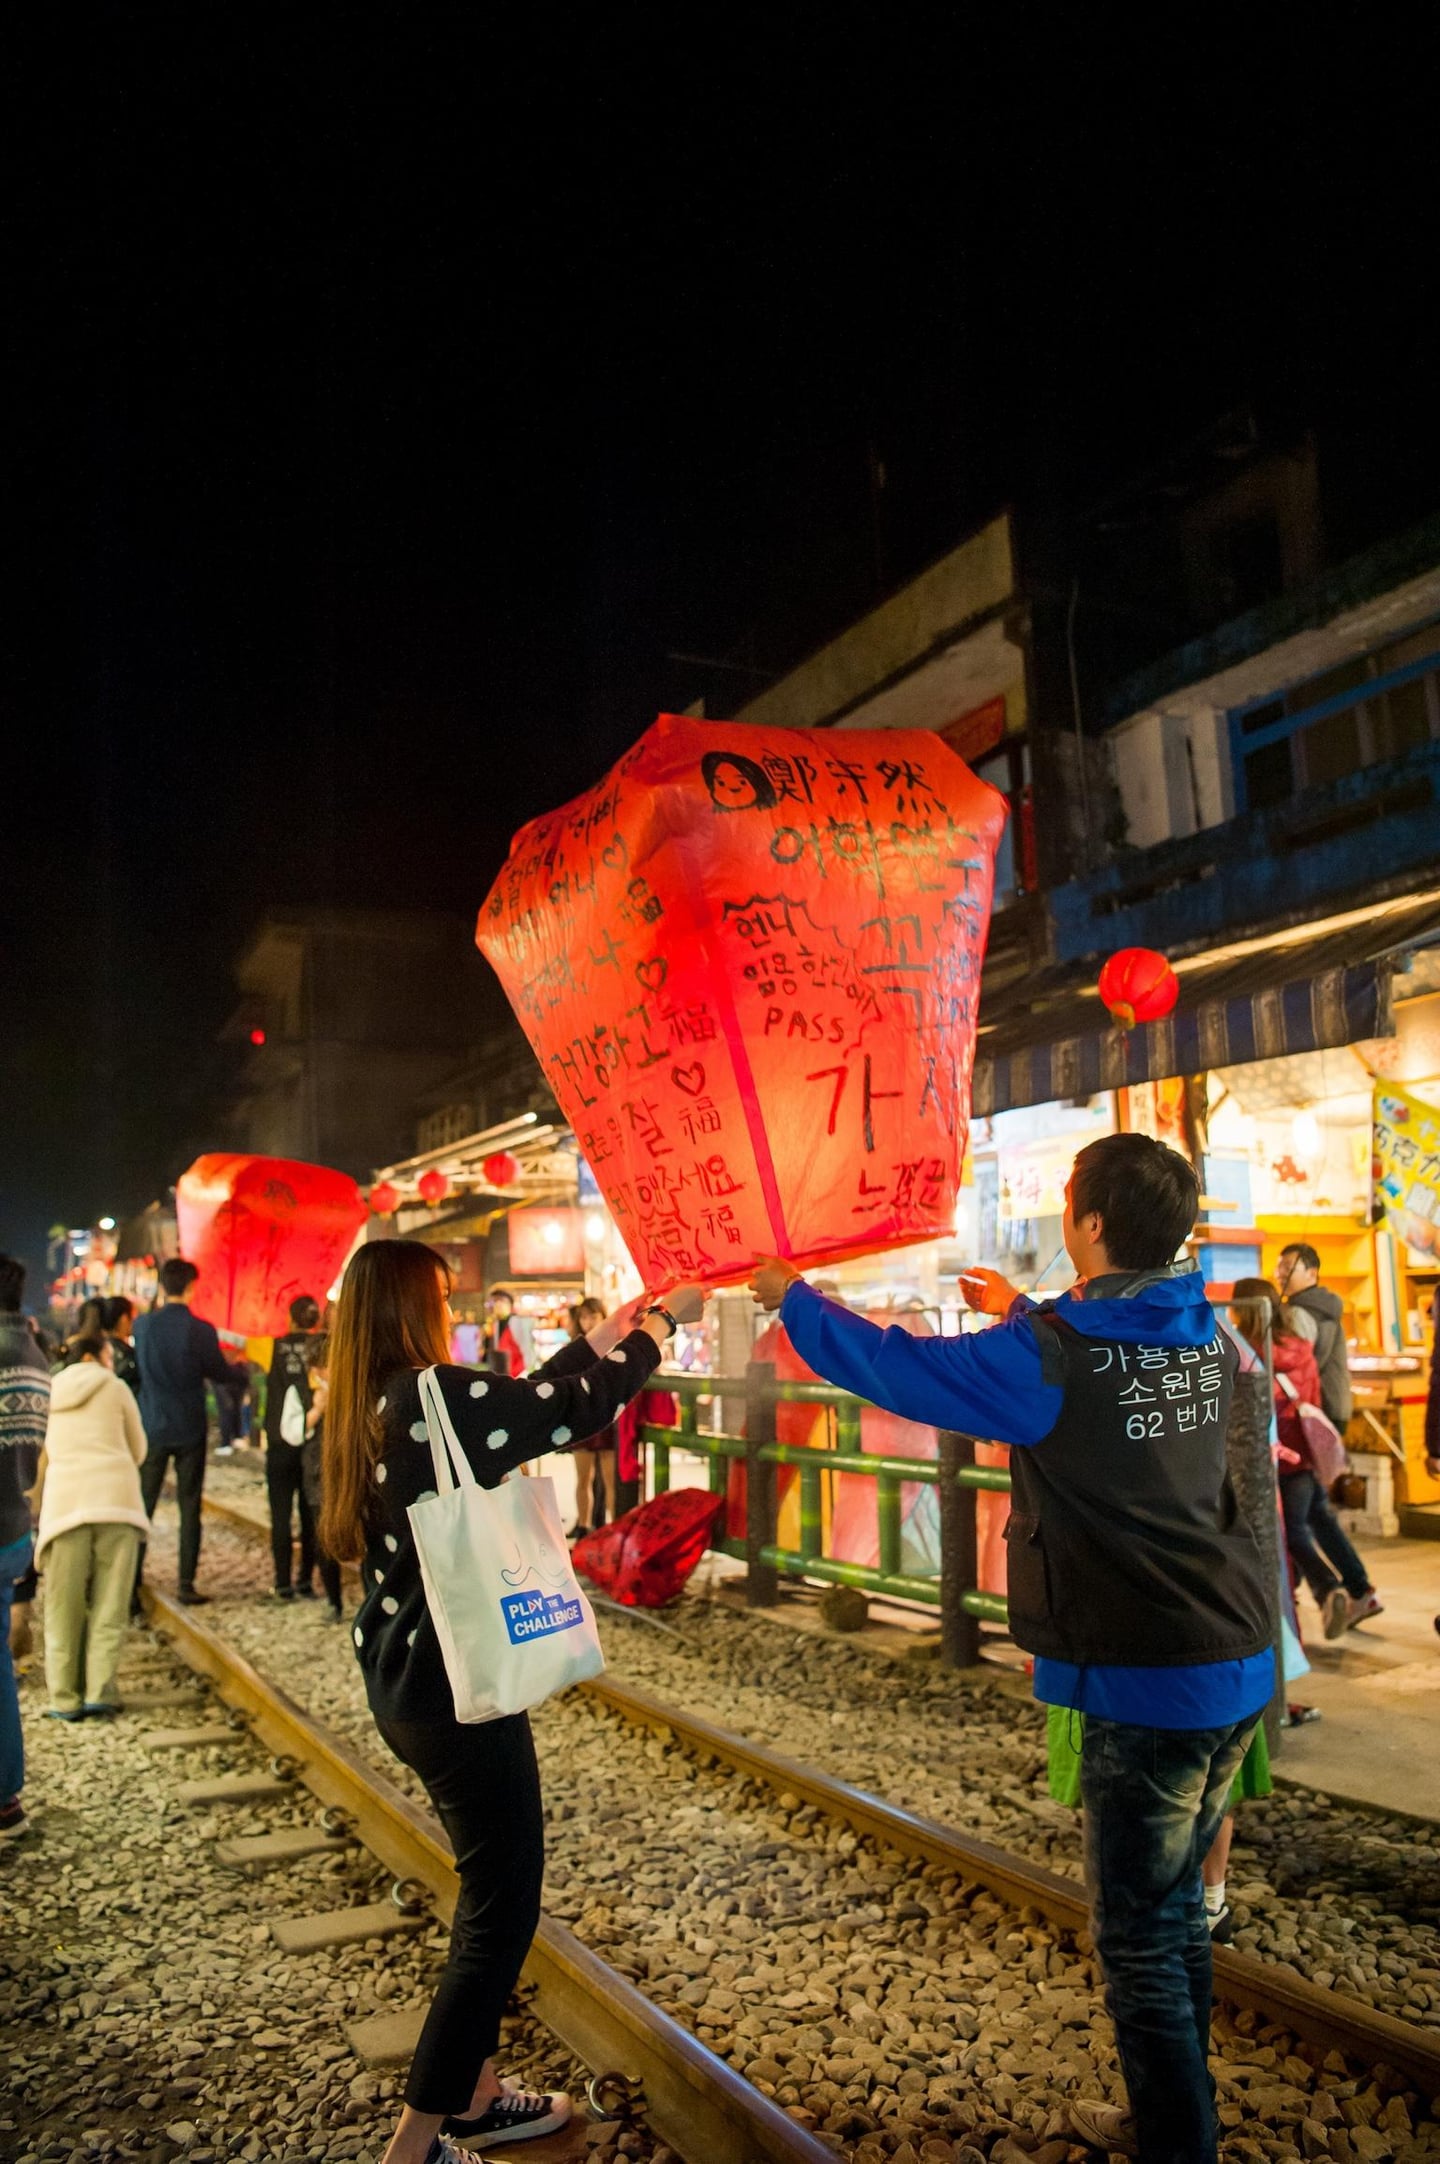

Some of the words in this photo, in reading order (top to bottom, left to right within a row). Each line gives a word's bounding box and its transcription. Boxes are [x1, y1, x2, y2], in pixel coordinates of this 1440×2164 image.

[763, 1005, 845, 1043] PASS
[678, 1096, 722, 1146] 福
[1117, 1362, 1223, 1406] 소원등
[1126, 1411, 1165, 1440] 62
[1176, 1396, 1219, 1433] 번지
[514, 1604, 580, 1637] CHALLENGE
[546, 1598, 560, 1609] THE
